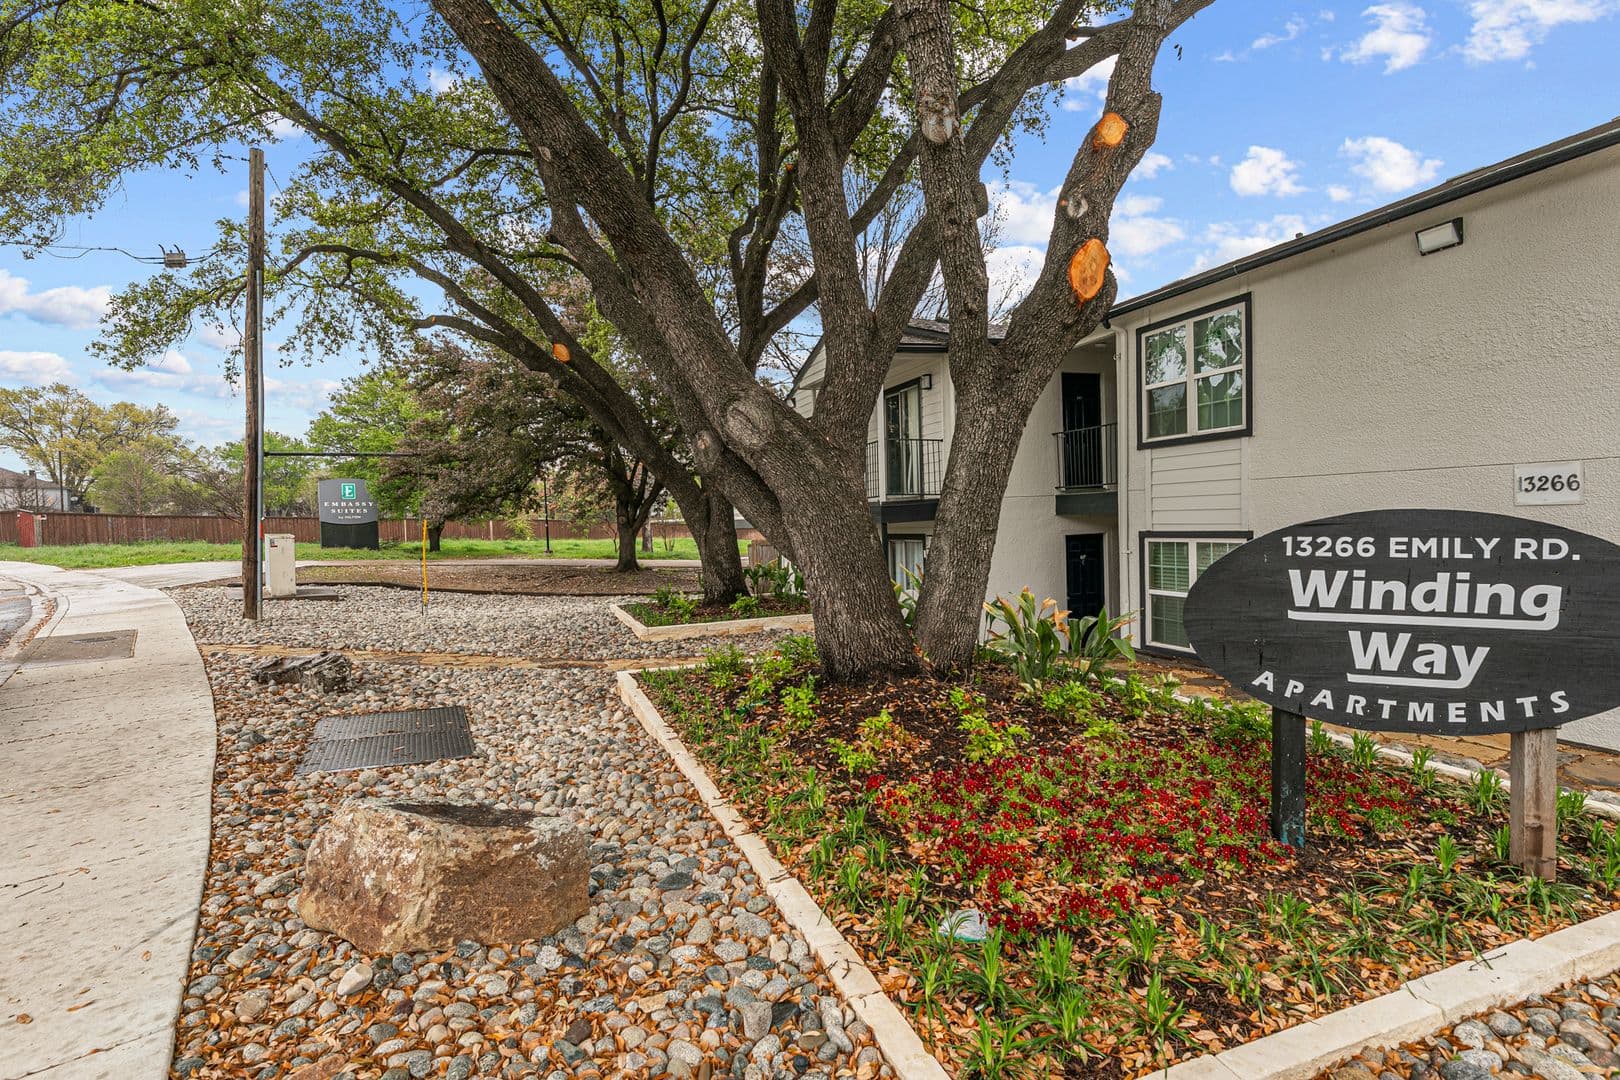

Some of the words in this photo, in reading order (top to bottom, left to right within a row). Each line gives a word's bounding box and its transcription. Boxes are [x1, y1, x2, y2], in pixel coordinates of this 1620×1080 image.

[1518, 474, 1580, 493] 13266
[1281, 536, 1376, 558] 13266
[1389, 537, 1501, 559] EMILY
[1514, 537, 1581, 561] RD.
[1287, 569, 1563, 631] Winding
[1346, 630, 1491, 689] Way
[1251, 670, 1570, 723] APARTMENTS
